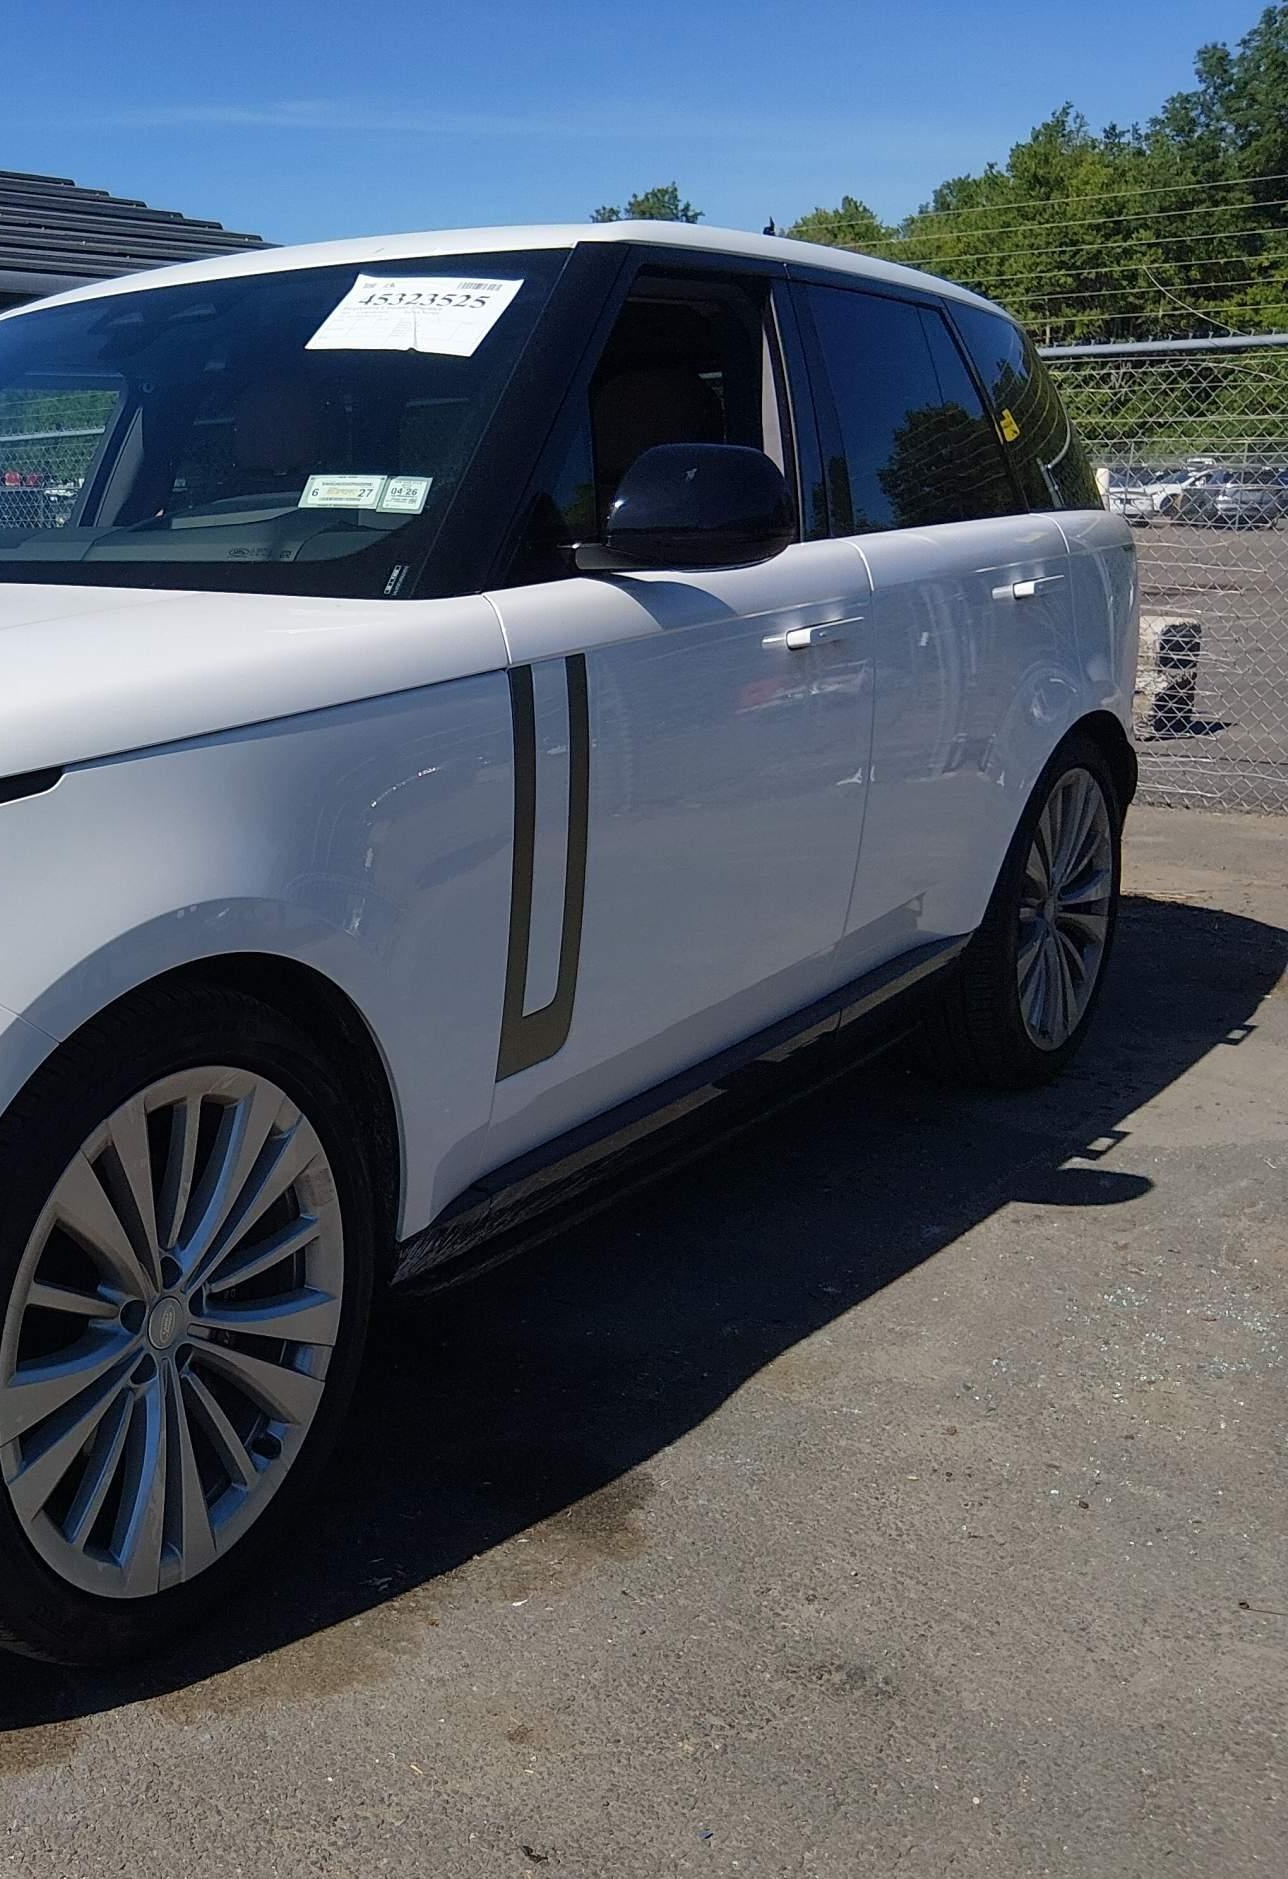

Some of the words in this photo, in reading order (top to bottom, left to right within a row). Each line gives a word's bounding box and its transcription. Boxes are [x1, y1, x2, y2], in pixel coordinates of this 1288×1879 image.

[358, 292, 491, 309] 45323525
[311, 488, 320, 497] 6
[358, 488, 374, 498] 27
